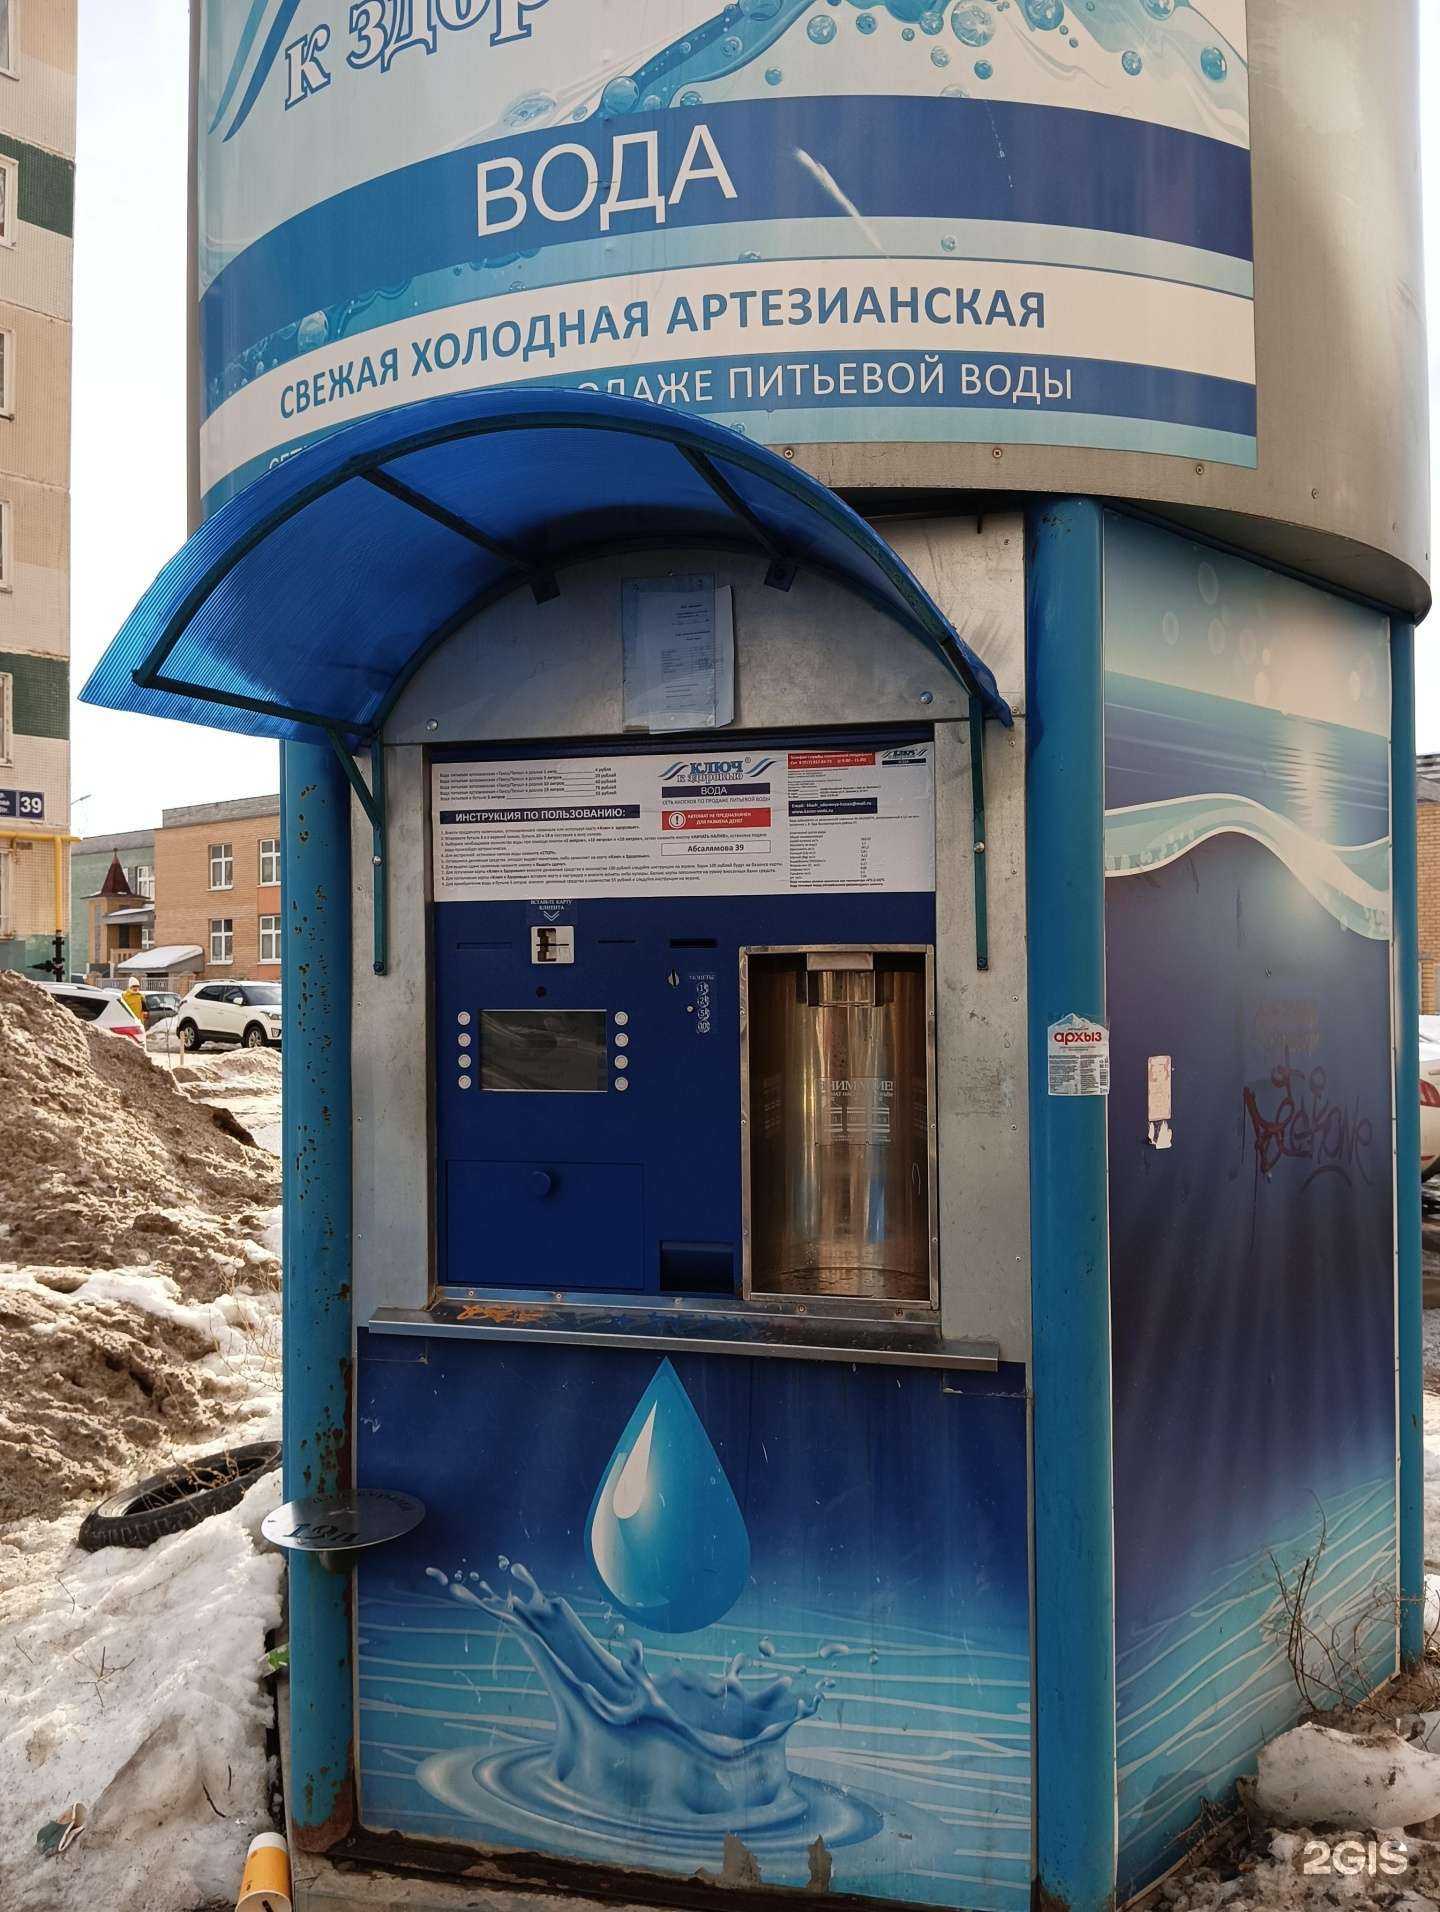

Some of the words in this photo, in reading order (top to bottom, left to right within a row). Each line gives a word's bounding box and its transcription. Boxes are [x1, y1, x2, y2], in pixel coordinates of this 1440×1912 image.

[476, 124, 738, 237] ВОДА
[280, 347, 400, 419] СВЕЖАЯ
[411, 300, 649, 378] ХОЛОДНАЯ
[666, 286, 1046, 334] АРТЕЗИАНСКАЯ
[577, 369, 713, 405] ДАЖЕ
[727, 354, 944, 398] ПИТЬЕВОЙ
[961, 363, 1073, 404] ВОДЫ
[700, 786, 728, 796] ВОДА
[20, 796, 42, 814] 39
[455, 811, 521, 823] ИНСТРУКЦИЯ
[524, 811, 538, 820] ПО
[541, 808, 626, 820] ПОЛЬЗОВАНИЮ:
[735, 843, 744, 851] 39
[1054, 1031, 1102, 1045] архыз
